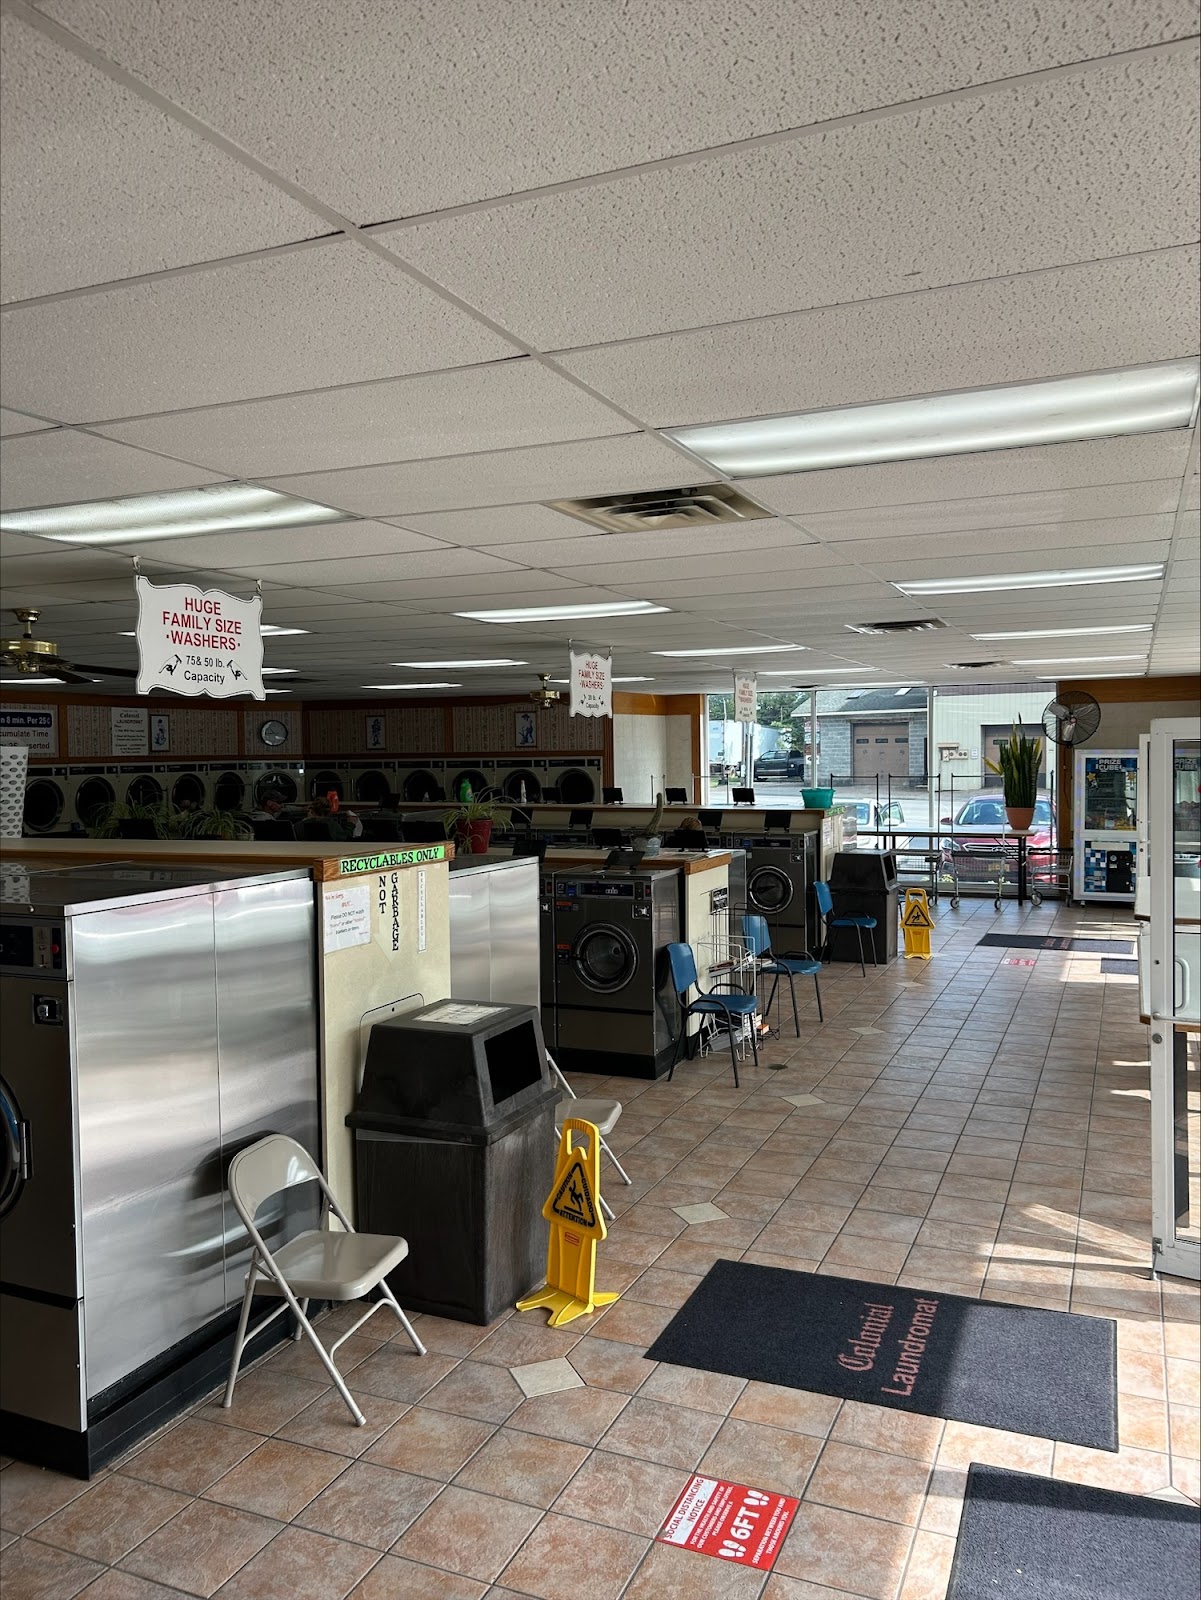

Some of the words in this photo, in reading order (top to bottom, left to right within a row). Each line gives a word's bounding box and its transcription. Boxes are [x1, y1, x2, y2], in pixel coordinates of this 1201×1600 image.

[185, 597, 221, 615] HUGE
[163, 611, 211, 631] FAMILY
[215, 618, 242, 635] SIZE
[184, 670, 225, 685] Capacity
[186, 655, 202, 666] 75&
[204, 657, 214, 667] 50
[215, 658, 225, 668] lb.
[578, 669, 595, 679] FAMILY
[596, 671, 605, 680] SIZE
[586, 661, 598, 670] HUGE
[27, 716, 38, 724] Per
[341, 852, 414, 873] RECYCLABLES
[416, 848, 439, 862] ONLY
[379, 875, 387, 914] NOT
[391, 872, 400, 951] GARBAGE
[556, 1172, 573, 1200] CAUTION
[581, 1178, 594, 1213] CUIDADO
[837, 1302, 894, 1371] Colonial
[881, 1298, 940, 1396] Laundromat
[664, 1516, 683, 1539] SOCIAL
[678, 1479, 704, 1515] DISTANCING
[687, 1499, 705, 1522] NOTICE
[690, 1536, 698, 1544] FOR
[694, 1528, 702, 1536] THE
[699, 1513, 710, 1528] HEALTH
[707, 1505, 715, 1514] AND
[711, 1491, 722, 1505] SAFETY
[712, 1521, 723, 1536] PLEASE
[720, 1504, 731, 1521] OBSERVE
[731, 1507, 759, 1539] 6FT
[697, 1539, 705, 1548] OUR
[702, 1516, 717, 1539] CUSTOMERS
[714, 1507, 722, 1516] AND
[752, 1537, 768, 1563] SEPARATION
[765, 1516, 777, 1536] BETWEEN
[773, 1507, 781, 1516] YOU
[766, 1539, 777, 1554] THOSE
[773, 1521, 784, 1539] AROUND
